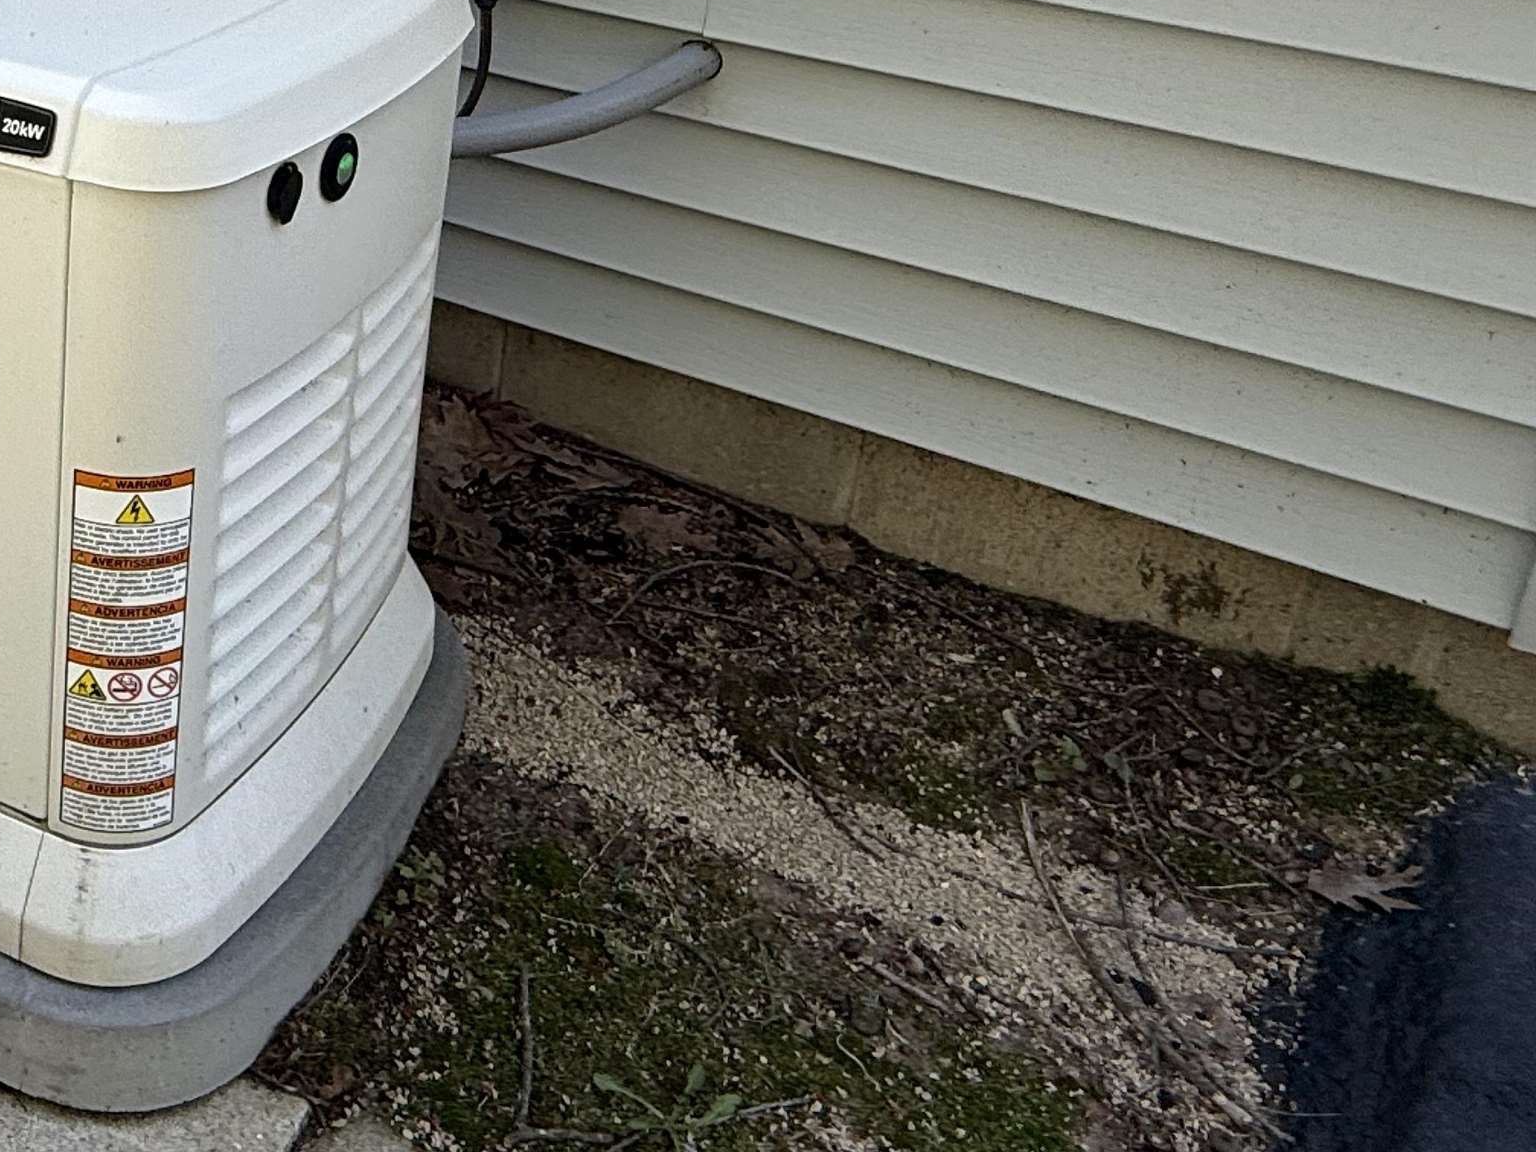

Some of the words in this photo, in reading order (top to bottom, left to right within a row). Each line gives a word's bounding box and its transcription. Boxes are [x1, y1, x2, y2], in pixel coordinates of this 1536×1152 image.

[1, 117, 45, 140] 20kW
[115, 478, 172, 489] WARNING
[91, 552, 185, 568] AVERTISSEMENT
[95, 603, 177, 617] ADVERTENCIA
[106, 656, 161, 667] WARNING
